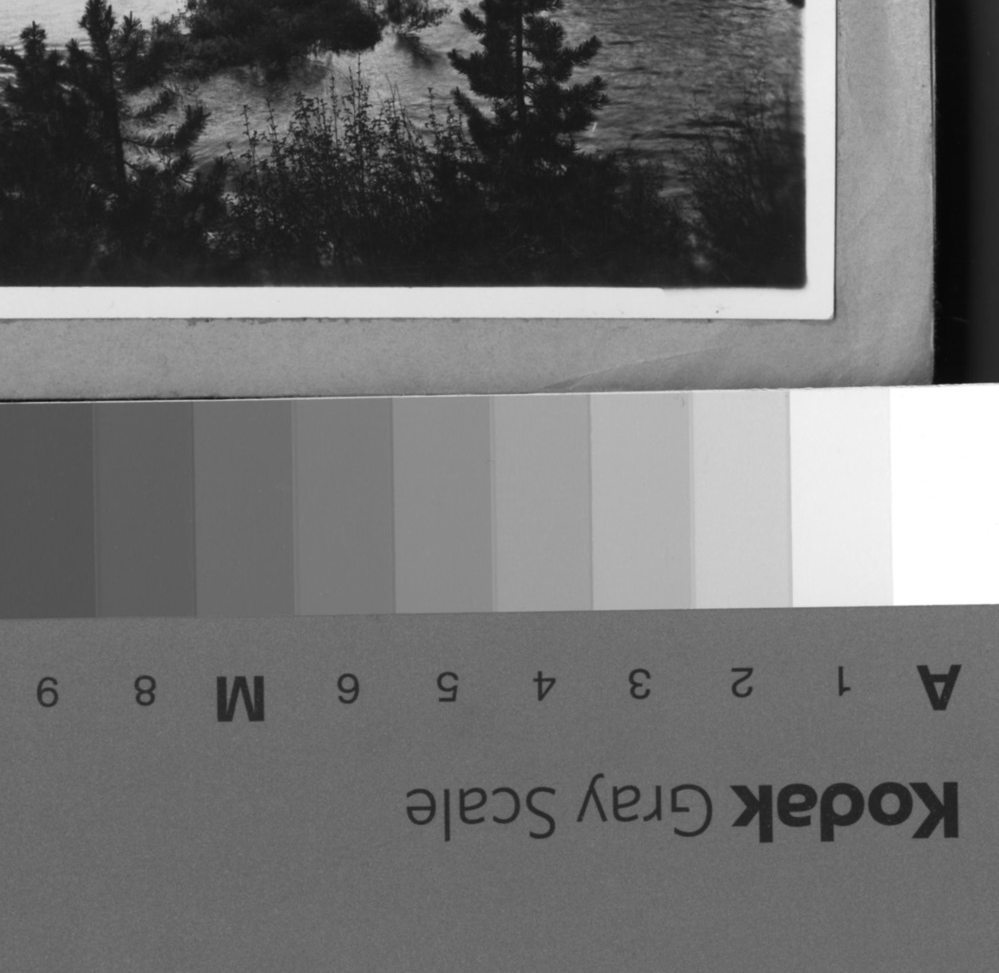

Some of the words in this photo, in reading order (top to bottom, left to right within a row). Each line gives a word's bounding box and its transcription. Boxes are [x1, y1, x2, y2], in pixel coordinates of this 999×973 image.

[36, 676, 59, 707] 9
[134, 675, 156, 706] 8
[337, 673, 360, 704] 6
[437, 671, 459, 702] 5
[533, 671, 556, 702] 4
[628, 668, 651, 700] 3
[731, 667, 754, 698] 2
[838, 666, 851, 696] 1
[916, 664, 962, 711] A
[216, 675, 265, 722] M
[405, 785, 557, 842] Scale
[577, 773, 714, 837] Gray
[730, 781, 960, 843] Kodak
